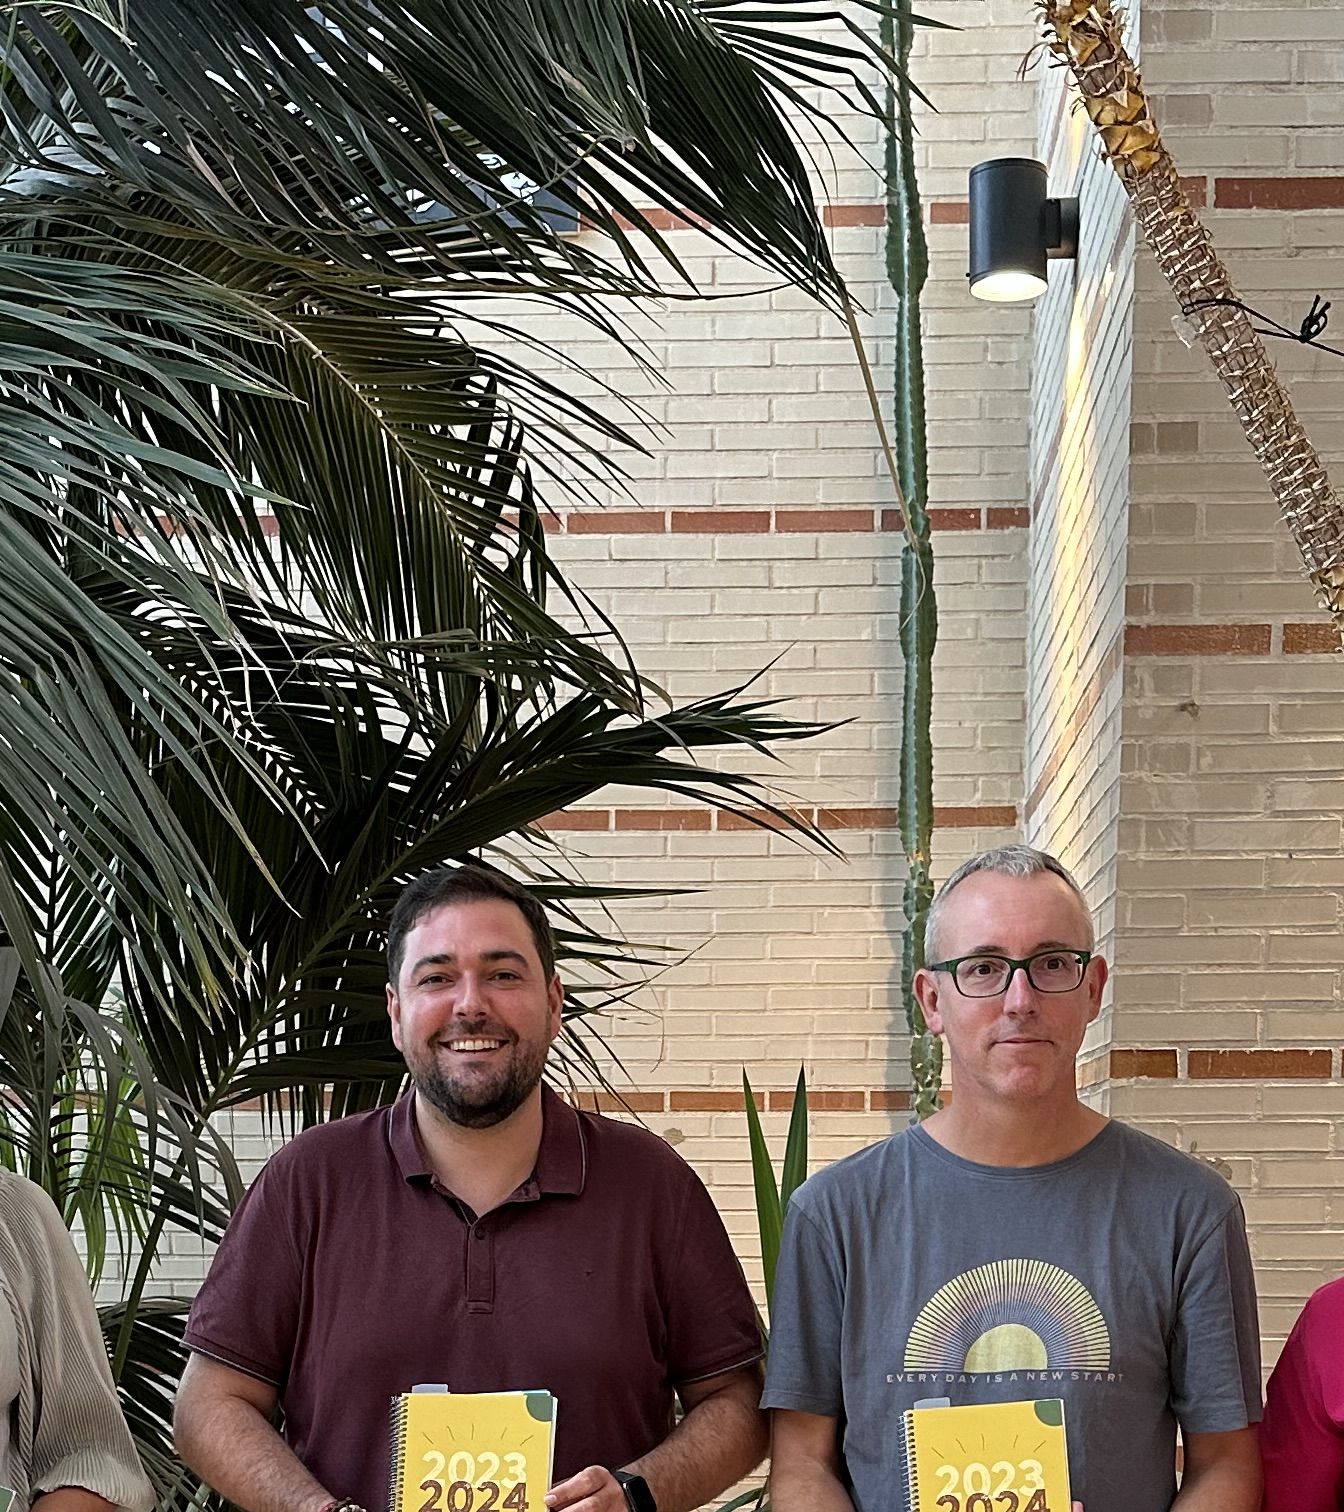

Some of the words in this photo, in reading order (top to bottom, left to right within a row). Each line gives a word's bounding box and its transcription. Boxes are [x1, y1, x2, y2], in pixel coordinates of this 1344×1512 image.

[886, 1373, 938, 1383] EVERY
[945, 1373, 978, 1383] DAY
[986, 1373, 1003, 1383] IS
[1009, 1372, 1018, 1381] A
[1026, 1371, 1064, 1381] NEW
[1070, 1371, 1124, 1383] START
[420, 1450, 527, 1489] 2023
[935, 1459, 1045, 1500] 2023
